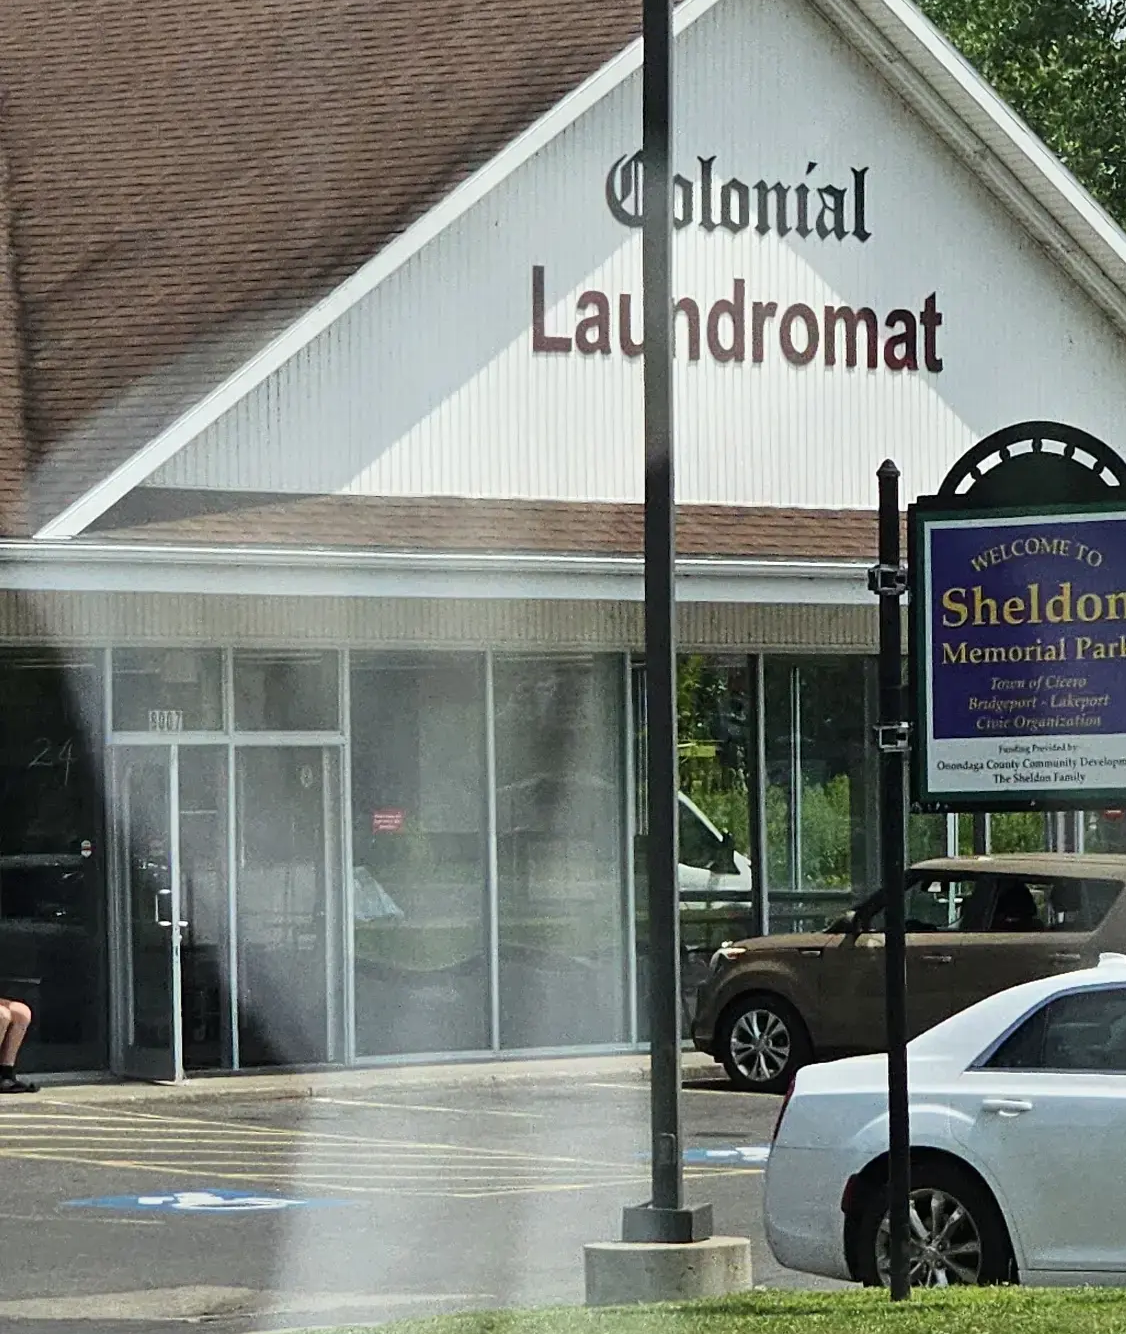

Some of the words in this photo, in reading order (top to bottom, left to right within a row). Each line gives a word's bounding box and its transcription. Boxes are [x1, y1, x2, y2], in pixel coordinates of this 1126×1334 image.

[605, 149, 872, 243] Colonial
[532, 265, 944, 373] Laundromat
[970, 537, 1072, 572] WELCOME
[1074, 541, 1104, 567] TO
[942, 637, 1067, 665] Memorial
[991, 676, 1025, 691] Town
[1028, 675, 1043, 691] of
[1045, 675, 1088, 690] Cicero
[969, 696, 1038, 713] Bridgeport
[1050, 693, 1110, 711] Lakeport
[976, 716, 1010, 730] Civic
[1014, 714, 1102, 732] Organization
[1032, 743, 1066, 753] Provided
[937, 760, 984, 772] Onondaga
[986, 759, 1020, 772] County
[1022, 757, 1077, 769] Community
[993, 773, 1011, 784] The
[1013, 773, 1051, 784] Sheldon
[1053, 772, 1087, 785] Family
